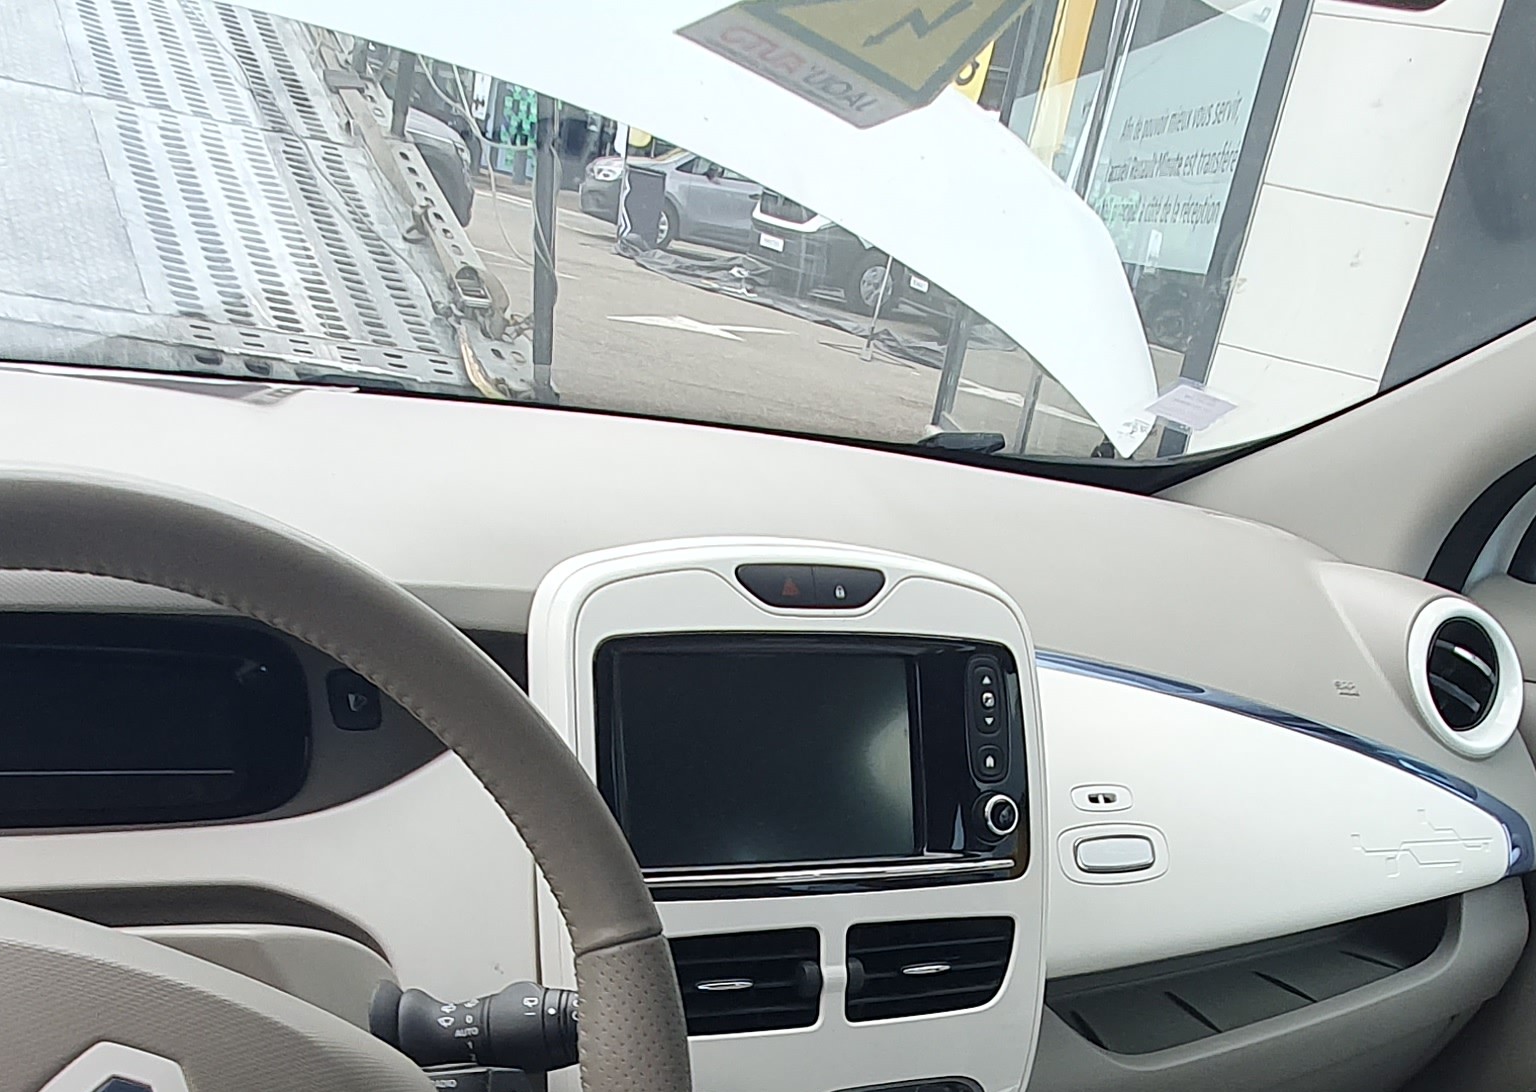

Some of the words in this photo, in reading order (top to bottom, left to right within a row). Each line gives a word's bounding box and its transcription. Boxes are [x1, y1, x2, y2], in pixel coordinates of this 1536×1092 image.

[1192, 104, 1213, 128] vous
[1182, 149, 1199, 176] est
[455, 1027, 479, 1038] AUTO
